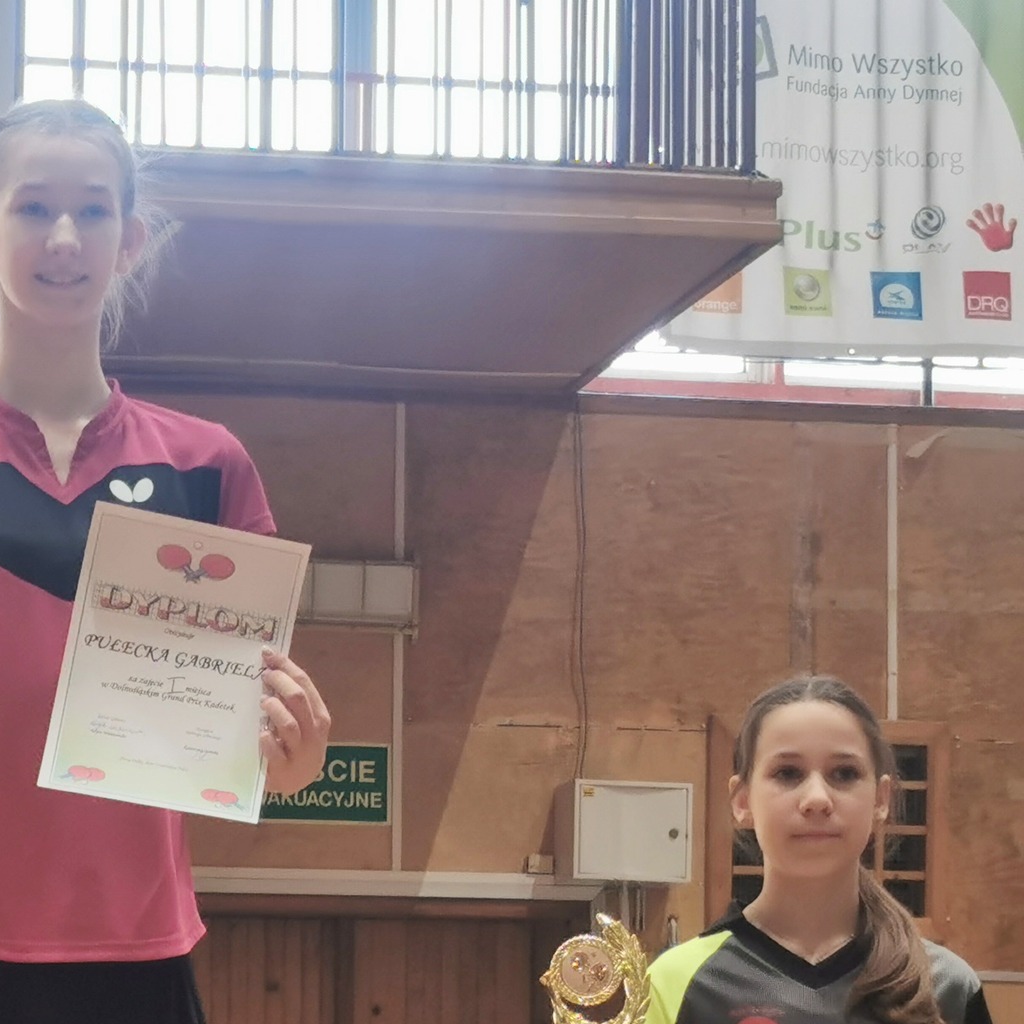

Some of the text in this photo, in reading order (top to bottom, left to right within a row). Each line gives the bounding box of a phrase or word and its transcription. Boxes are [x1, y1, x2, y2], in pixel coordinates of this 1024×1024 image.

[788, 44, 963, 81] Mimo Wszystko
[787, 76, 962, 106] Fundacja Anny Dymnej
[761, 137, 964, 175] mimowszystko.org
[779, 219, 861, 252] Plus
[98, 584, 278, 642] DYPLOM
[84, 633, 170, 663] PUŁECKA
